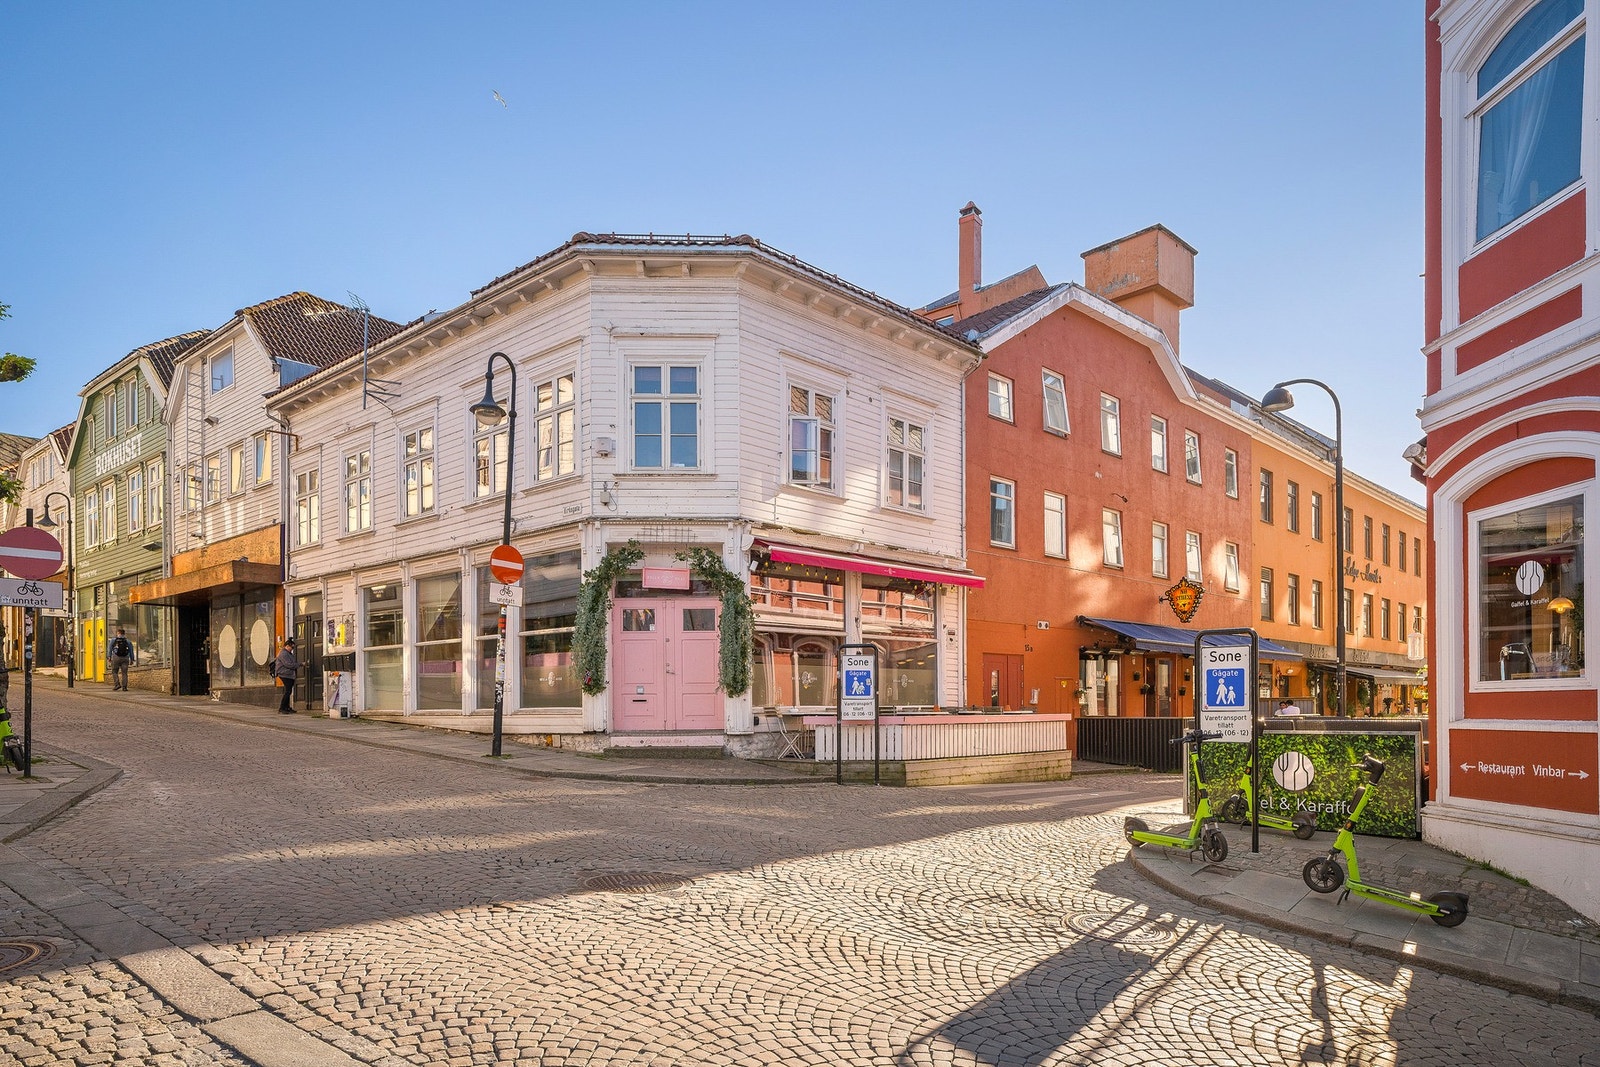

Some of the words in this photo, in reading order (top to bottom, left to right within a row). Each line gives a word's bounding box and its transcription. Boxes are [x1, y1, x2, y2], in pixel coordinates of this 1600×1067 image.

[12, 598, 48, 606] unntatt
[847, 658, 869, 666] Sone
[1209, 651, 1242, 663] Sone
[1212, 669, 1239, 678] Gågate
[1478, 761, 1525, 775] Restaurant
[1532, 764, 1565, 778] Vinbar
[1279, 797, 1290, 810] &
[1297, 798, 1354, 815] Karaff
